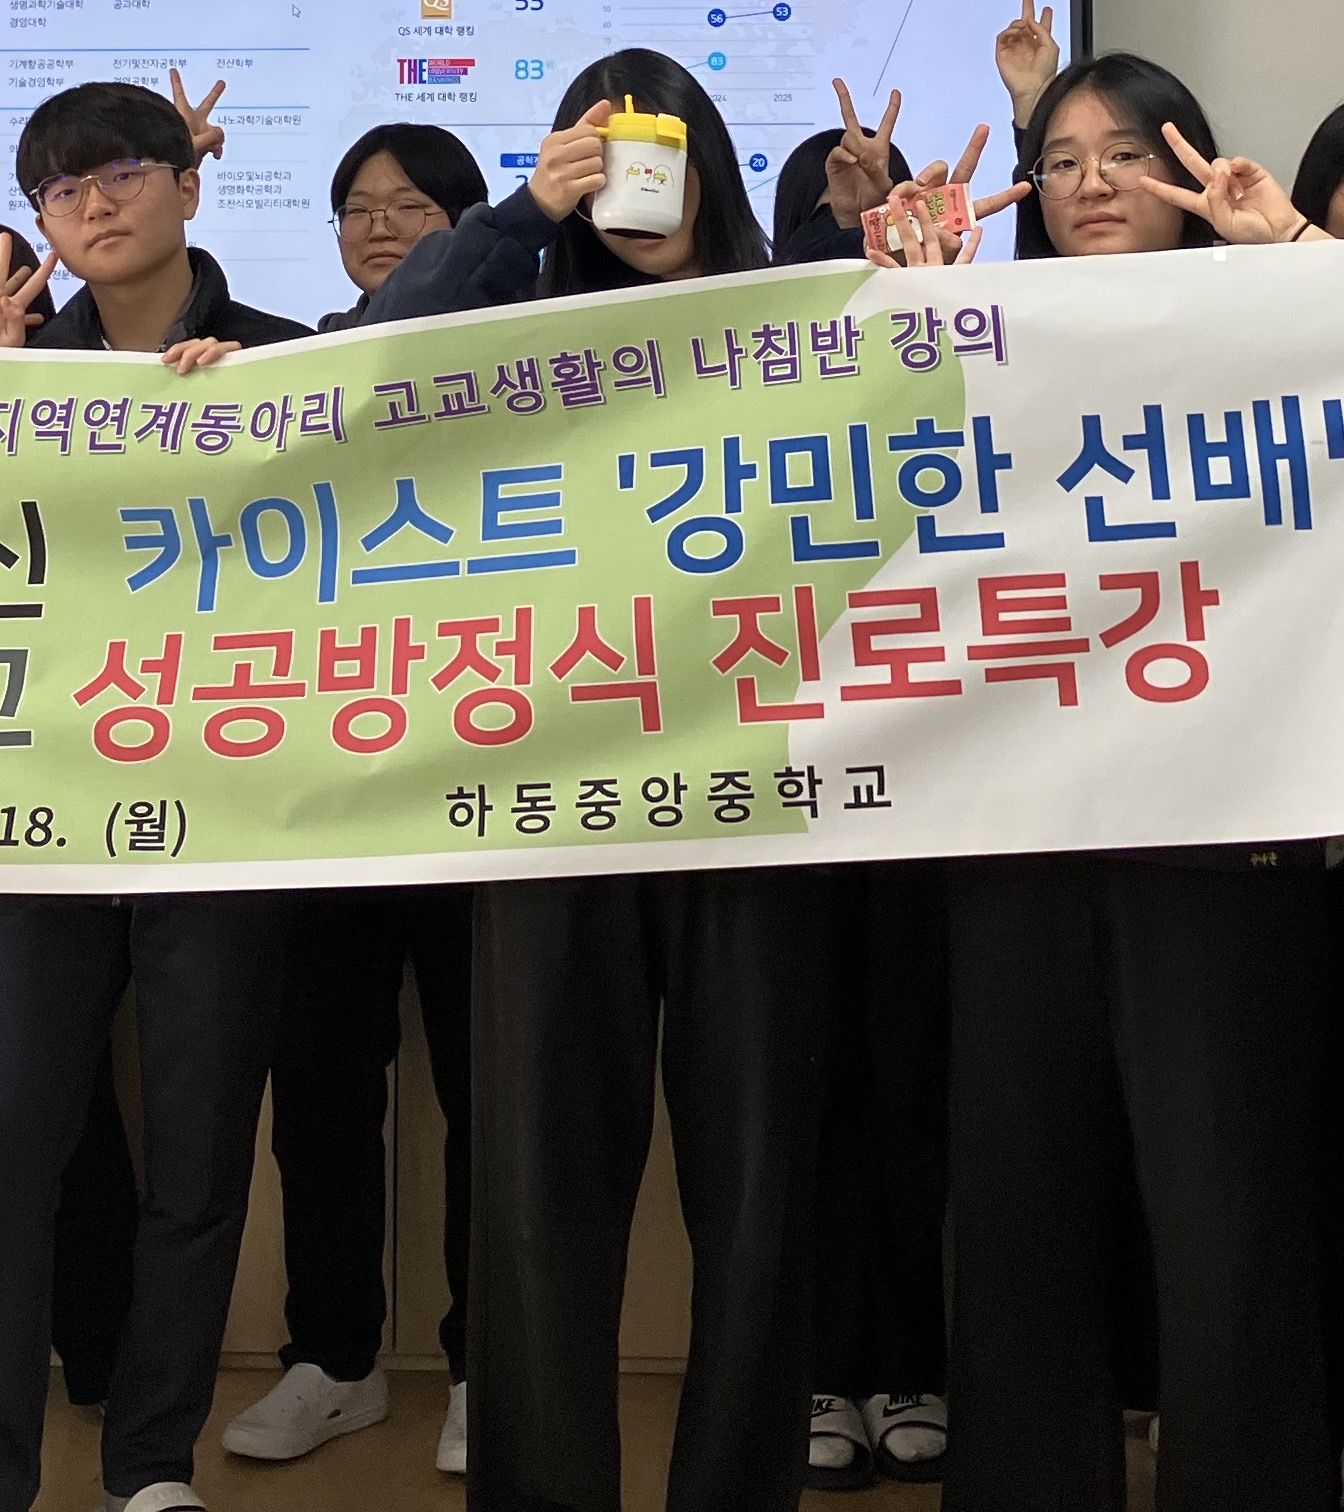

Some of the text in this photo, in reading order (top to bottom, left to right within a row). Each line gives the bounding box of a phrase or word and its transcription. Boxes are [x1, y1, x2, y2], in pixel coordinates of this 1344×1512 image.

[9, 0, 84, 11] 생명과학기술대학
[113, 0, 150, 10] 공과대학
[775, 7, 789, 17] 53
[710, 13, 724, 24] 56
[398, 26, 411, 36] QS
[413, 26, 432, 36] 세계
[435, 25, 453, 36] 대학
[216, 58, 253, 69] 전산학부
[397, 59, 427, 84] THE
[395, 92, 414, 102] THE
[416, 92, 435, 102] 세계
[438, 92, 457, 102] 대학
[752, 158, 765, 168] 20
[373, 338, 667, 431] 고교생활의
[692, 315, 864, 388] 나침반
[889, 303, 1008, 371] 강의
[119, 463, 579, 614] 카이스트
[72, 594, 663, 764] 성공방정식
[709, 560, 1222, 724] 진로특강
[444, 763, 892, 838] 하동중앙중학교
[104, 798, 188, 859] (월)
